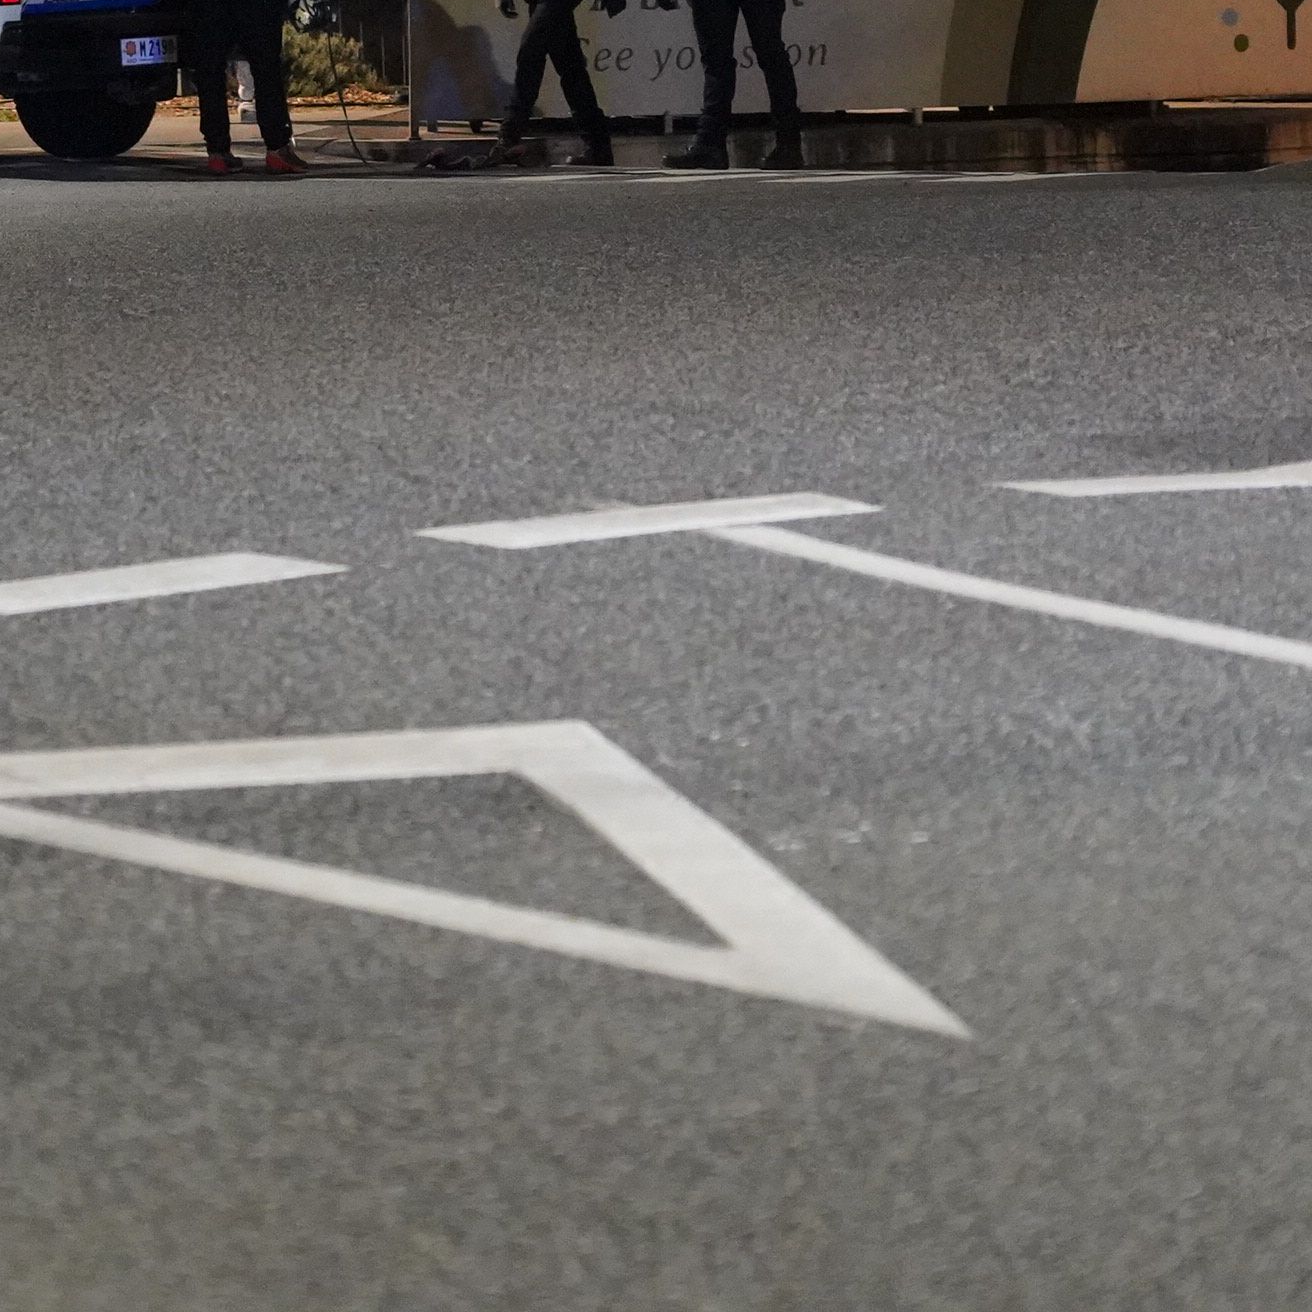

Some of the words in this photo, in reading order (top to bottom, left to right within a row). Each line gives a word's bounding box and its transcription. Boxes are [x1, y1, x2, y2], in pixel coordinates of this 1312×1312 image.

[579, 37, 633, 72] ee
[650, 46, 696, 82] yo
[740, 43, 827, 69] son
